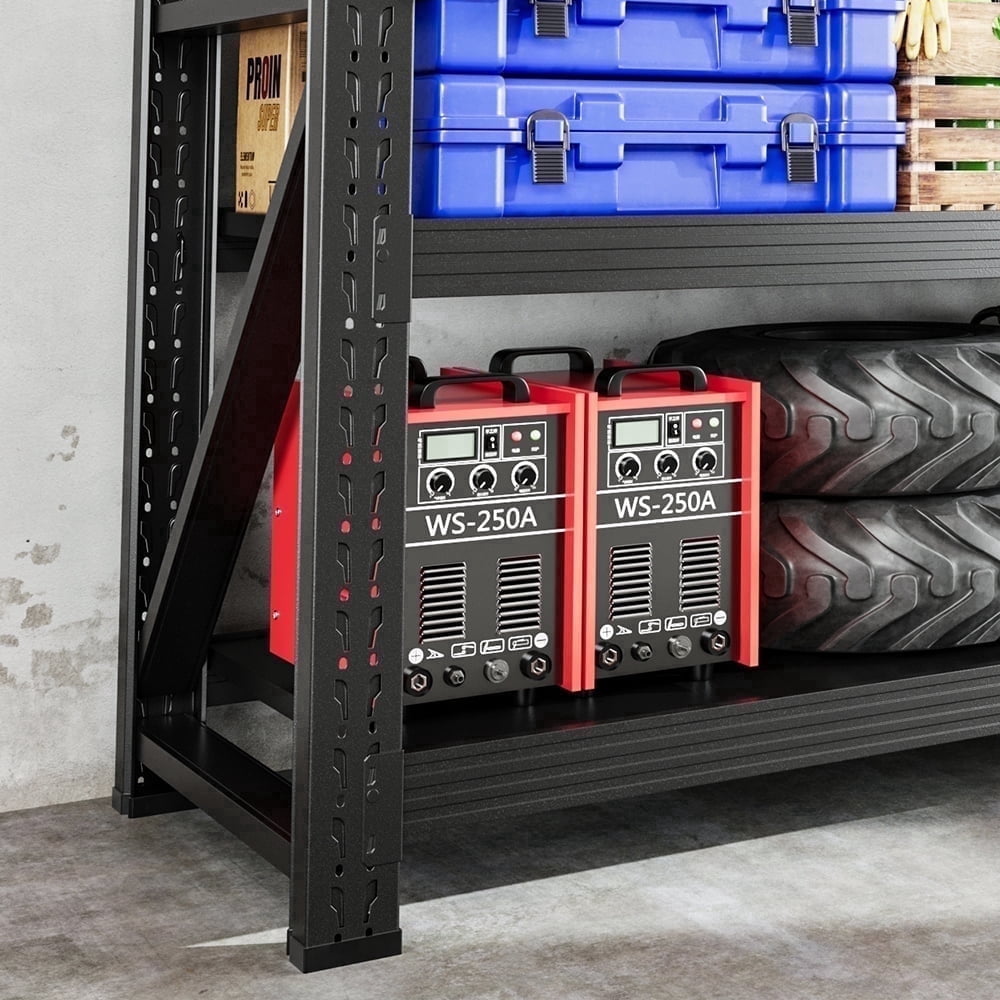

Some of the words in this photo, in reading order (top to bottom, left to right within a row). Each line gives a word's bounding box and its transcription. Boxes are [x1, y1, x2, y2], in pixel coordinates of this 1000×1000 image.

[246, 54, 282, 101] PROIN
[613, 489, 717, 520] WS-250A
[424, 505, 539, 538] WS-250A
